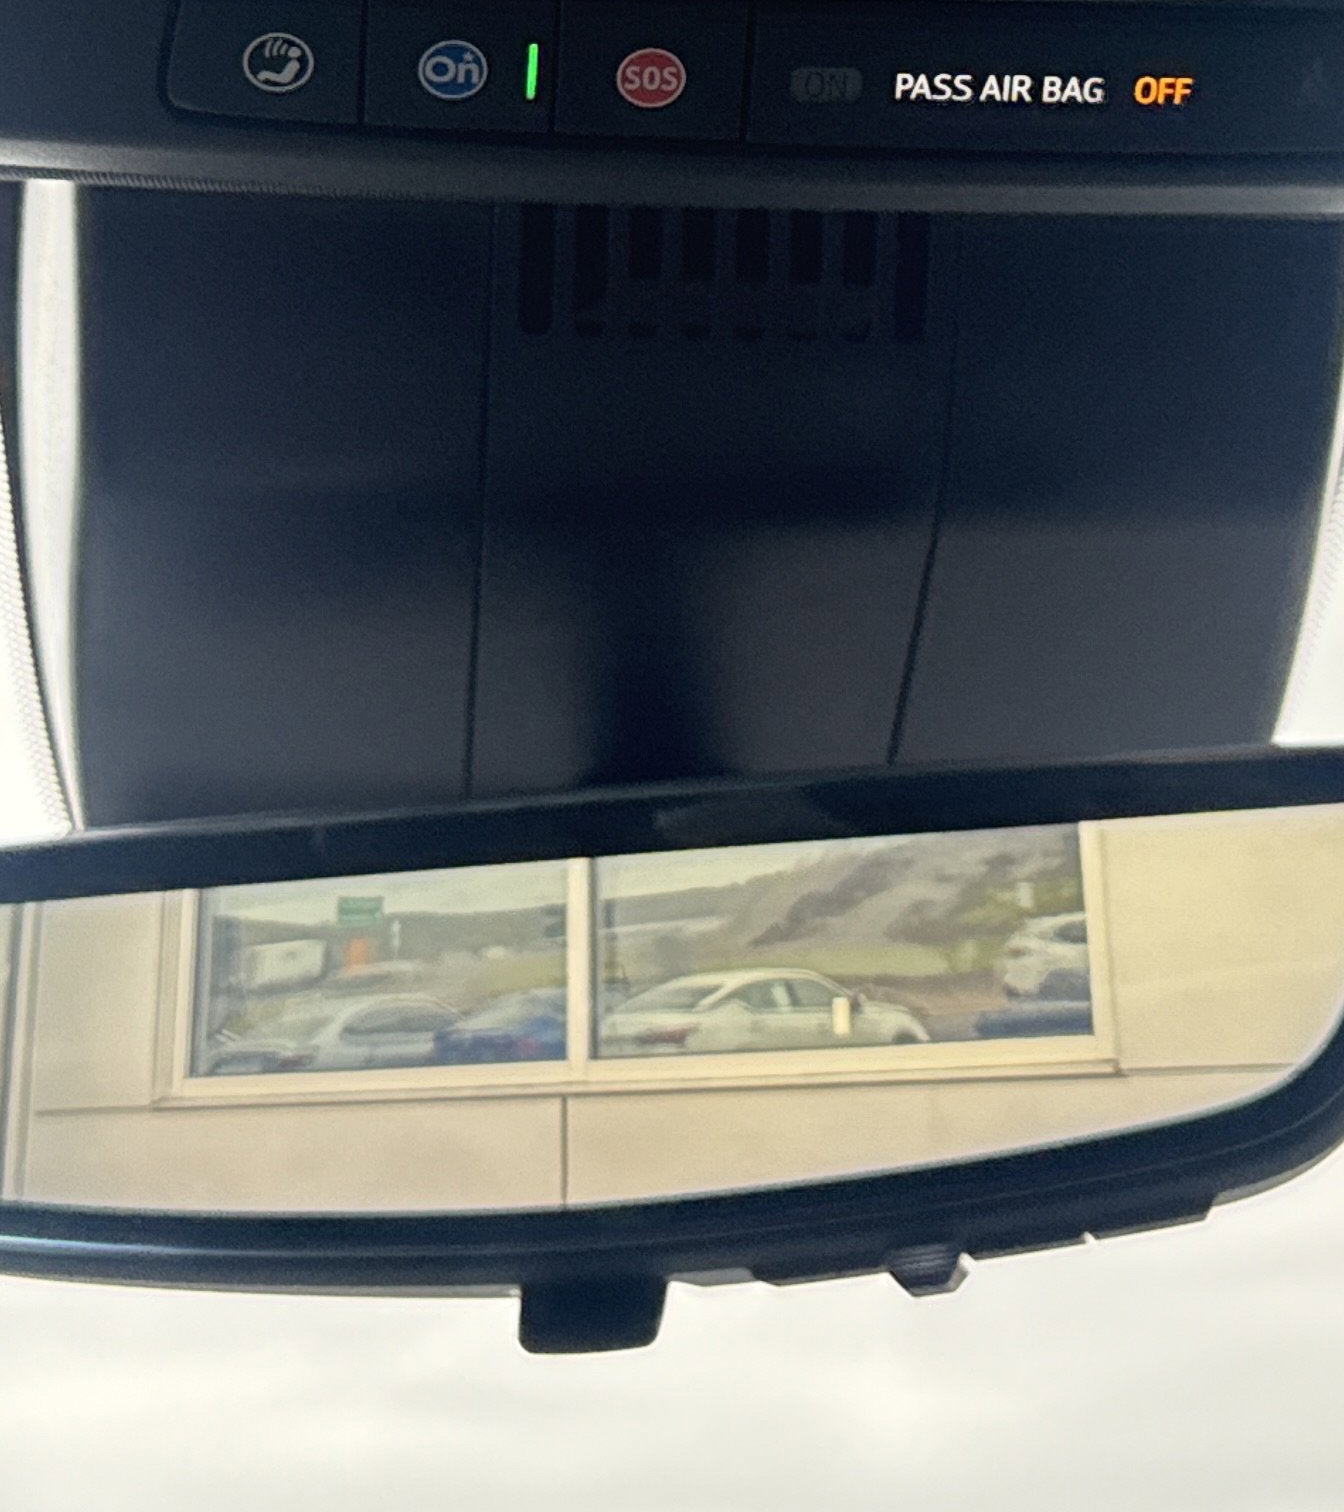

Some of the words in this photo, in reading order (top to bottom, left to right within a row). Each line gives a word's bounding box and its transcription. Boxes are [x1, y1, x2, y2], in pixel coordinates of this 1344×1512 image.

[624, 65, 678, 92] SOS
[805, 71, 848, 98] ON
[894, 72, 973, 102] PASS
[979, 74, 1033, 103] AIR
[1043, 76, 1105, 106] BAG
[1133, 76, 1194, 106] OFF
